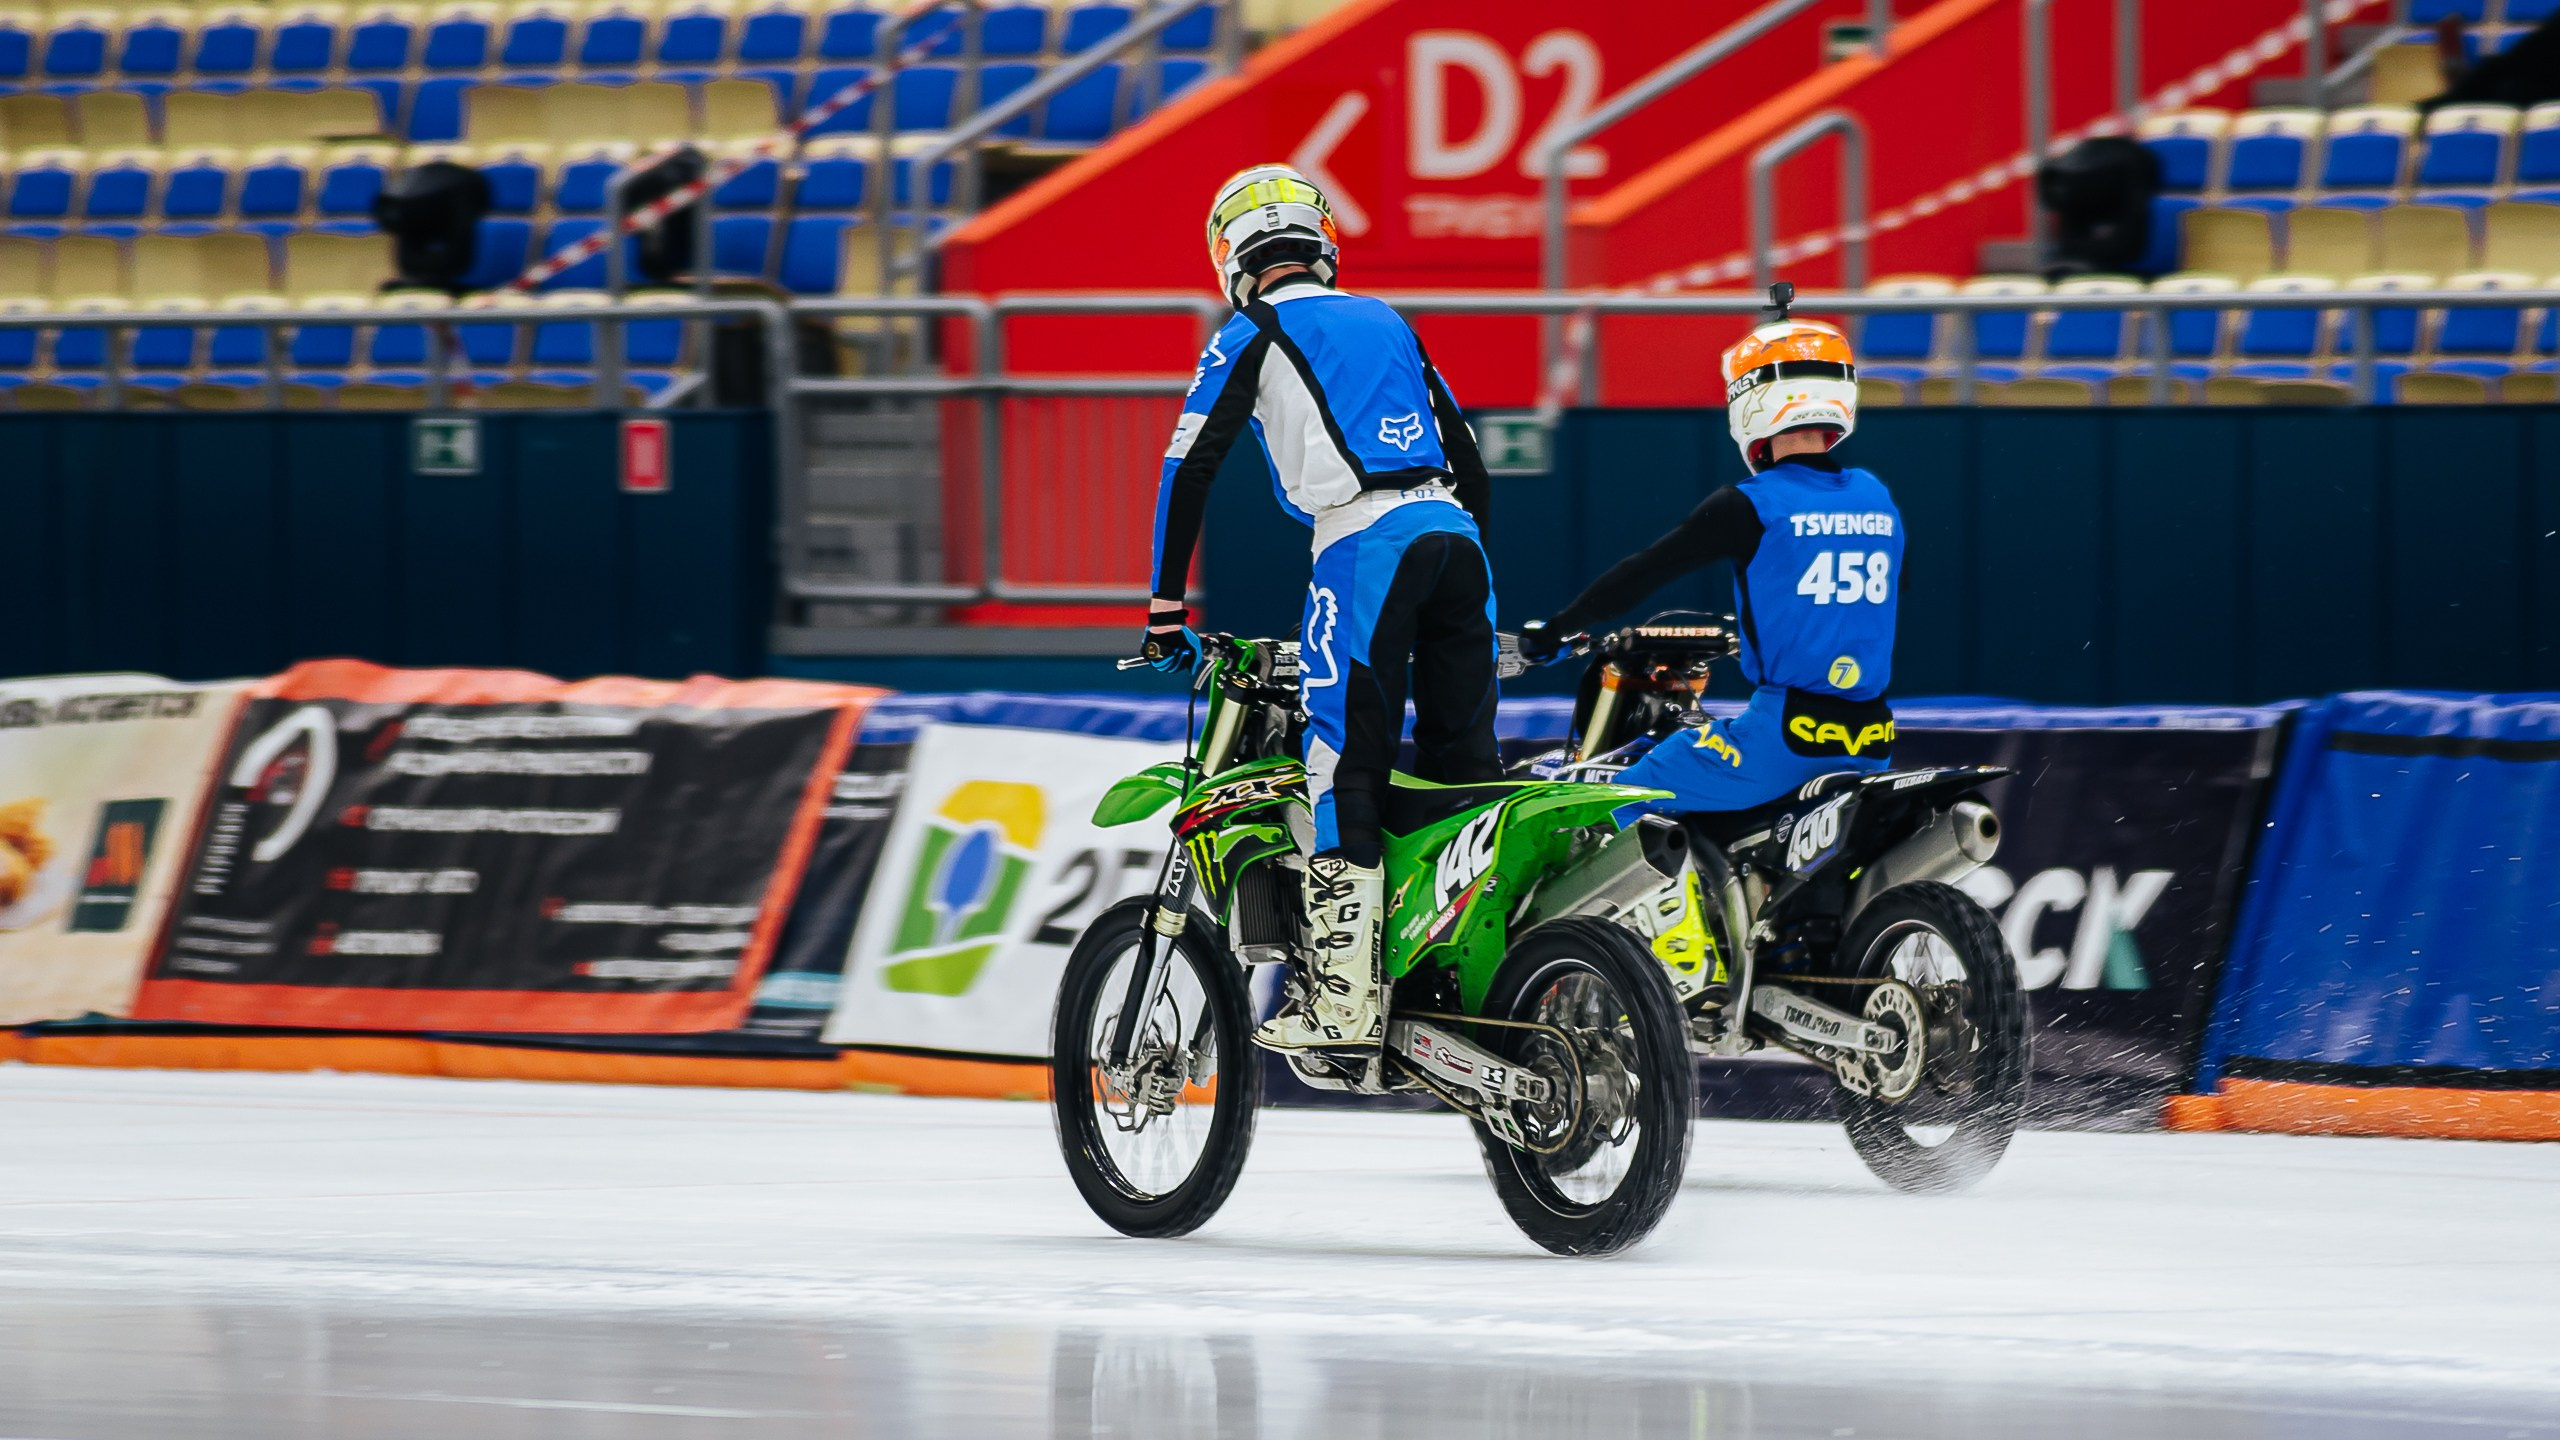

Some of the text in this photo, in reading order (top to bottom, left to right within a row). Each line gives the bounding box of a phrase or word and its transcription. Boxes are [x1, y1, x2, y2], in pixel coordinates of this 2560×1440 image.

[1406, 29, 1609, 180] D2
[1790, 512, 1893, 537] TSVENGER
[1796, 551, 1889, 605] 458
[1834, 662, 1854, 686] 7
[1434, 800, 1508, 914] 142
[1786, 791, 1853, 872] 458
